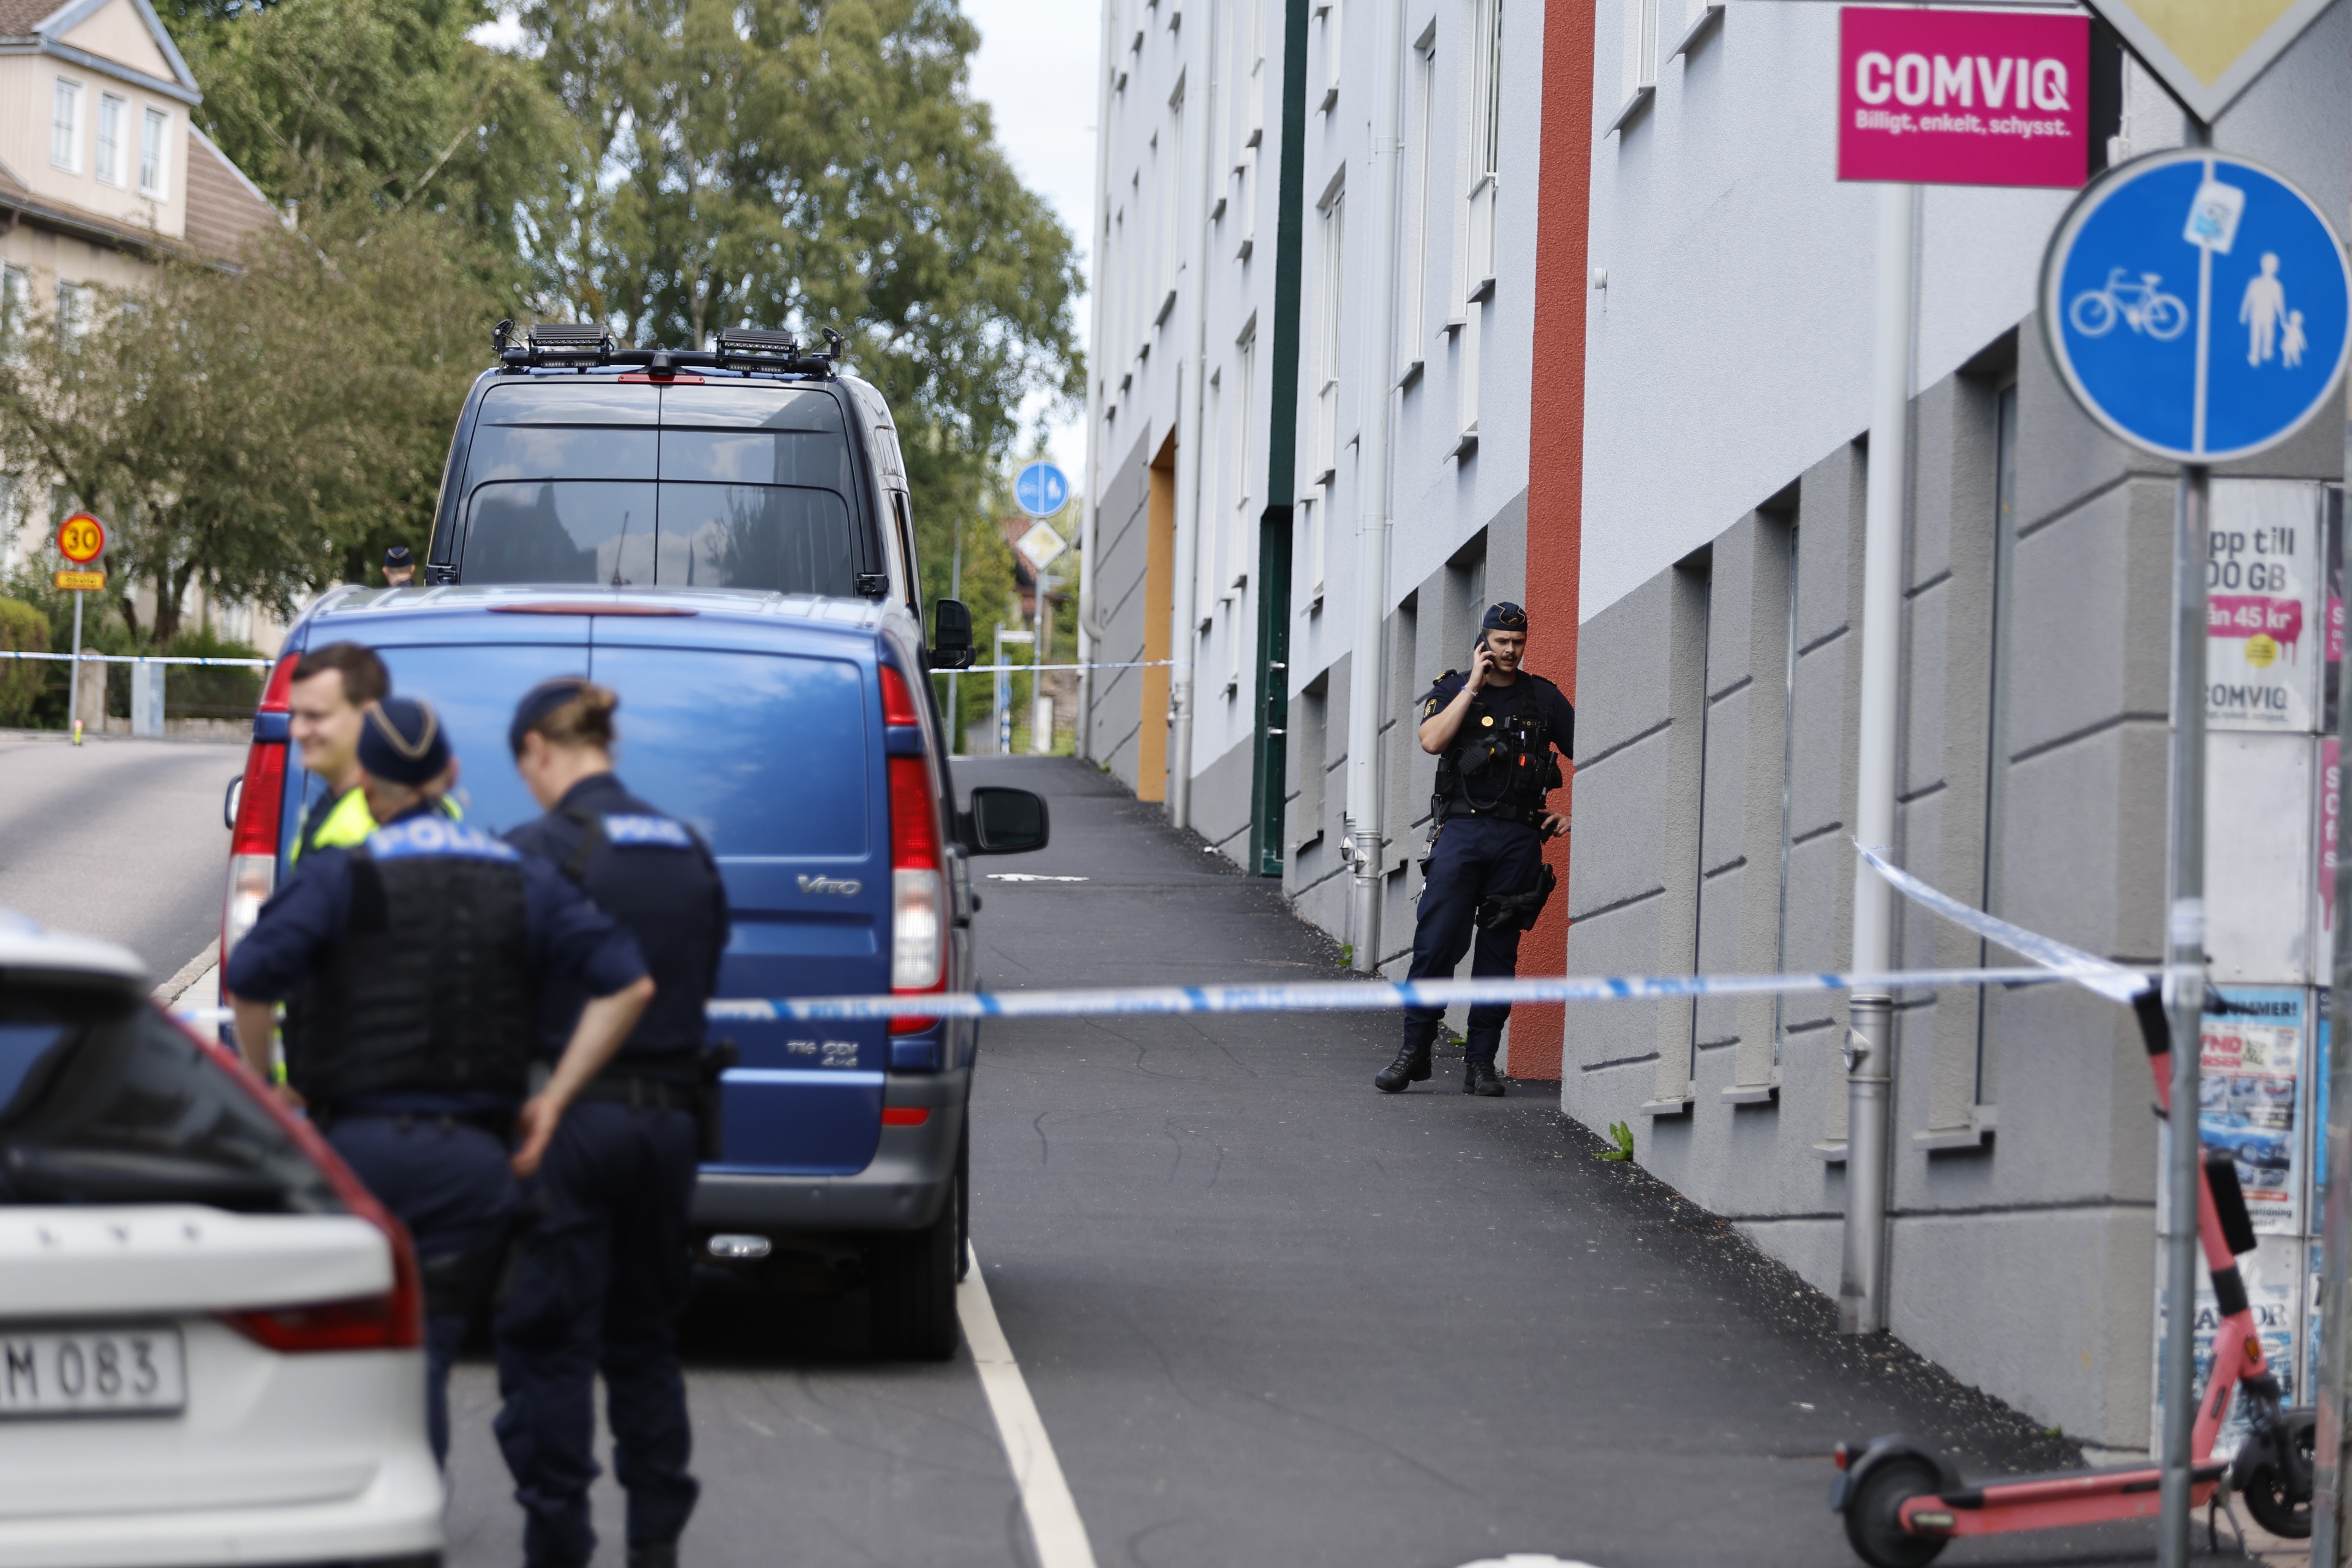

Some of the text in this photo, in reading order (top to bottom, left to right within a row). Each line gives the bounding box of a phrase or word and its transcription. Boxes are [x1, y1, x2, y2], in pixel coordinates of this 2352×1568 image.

[1856, 51, 2071, 111] COMVIQ
[1856, 109, 2071, 139] Billigt, enkelt, schysst.
[67, 527, 97, 550] 30
[2209, 527, 2294, 559] pp till
[2248, 562, 2286, 591] GB
[2207, 603, 2292, 629] ån 45 kr
[2206, 684, 2287, 710] OMVIQ
[5, 1340, 158, 1398] M 083
